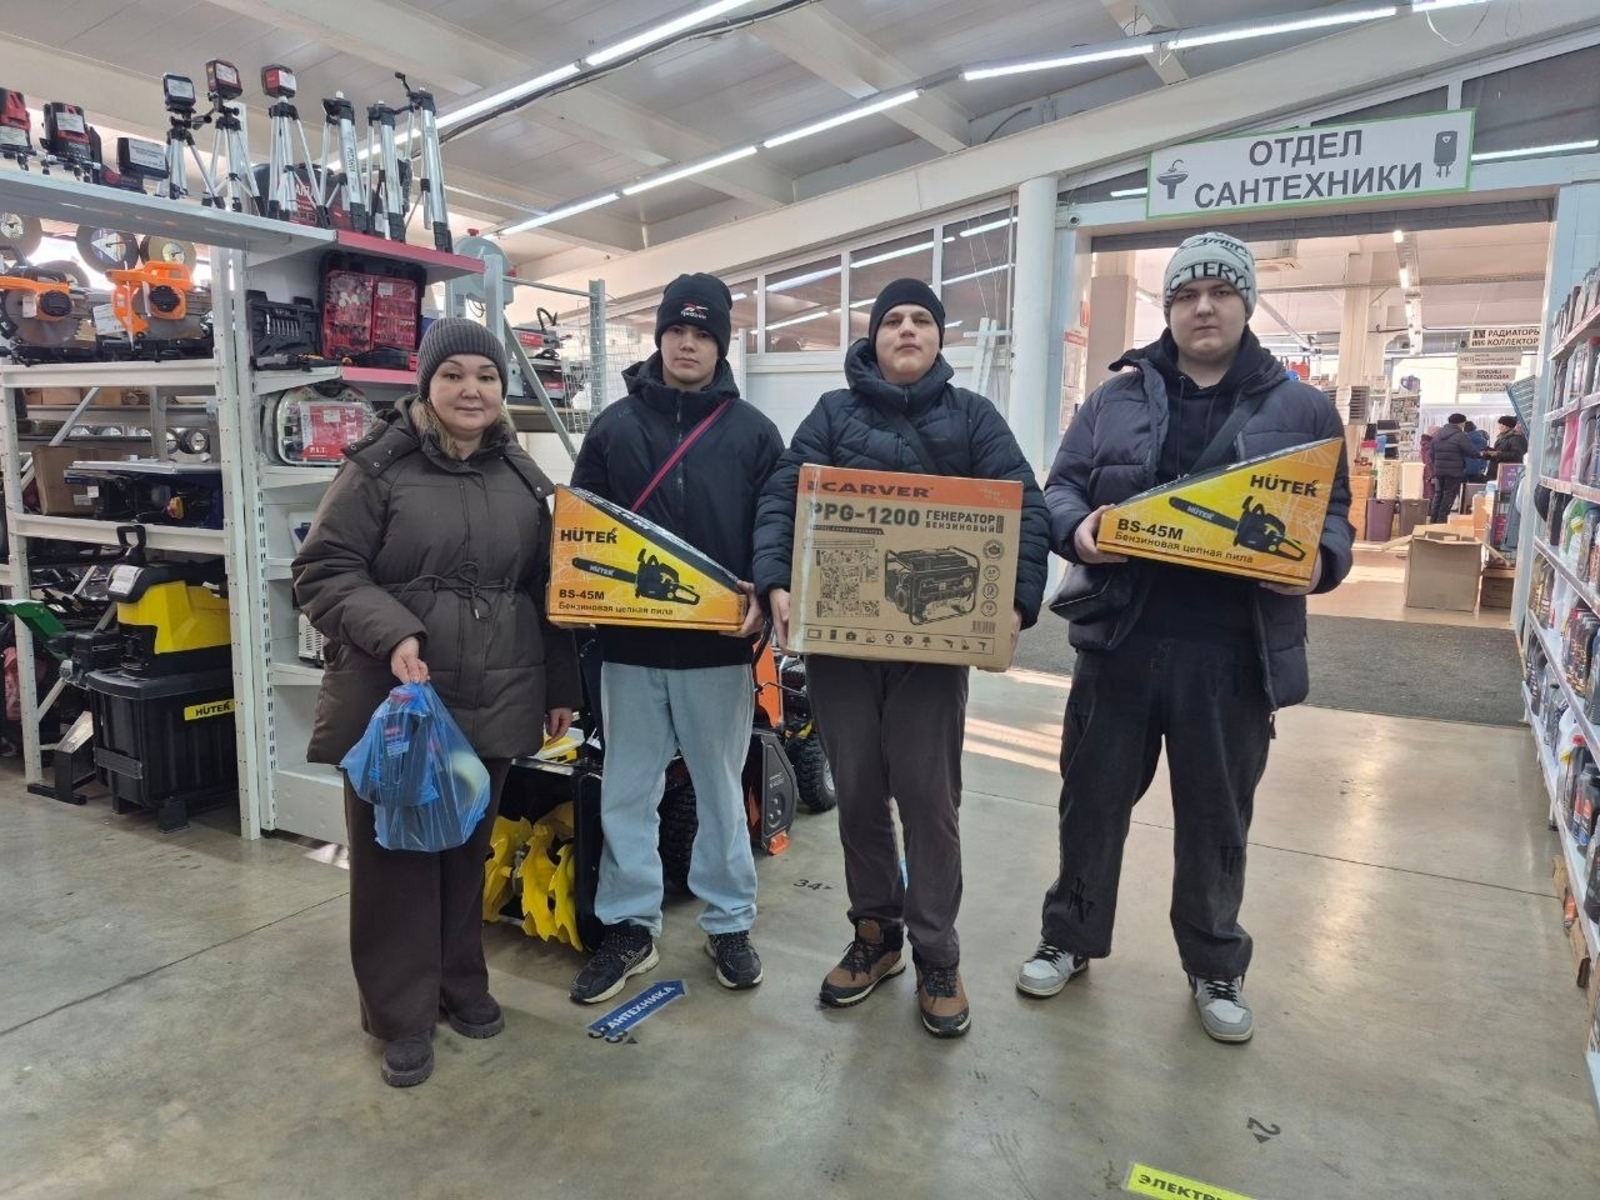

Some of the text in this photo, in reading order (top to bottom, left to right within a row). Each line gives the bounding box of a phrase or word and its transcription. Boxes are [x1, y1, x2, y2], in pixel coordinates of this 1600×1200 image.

[1249, 129, 1363, 167] ОТДЕЛ
[1194, 162, 1423, 208] САНТЕХНИКИ
[821, 482, 930, 498] CARVER
[1250, 473, 1318, 498] HÜTER
[810, 501, 920, 527] PPG-1200
[926, 509, 996, 524] ГЕНЕРАТОР
[560, 527, 618, 544] HÜTER
[925, 520, 995, 533] БЕНЗИНОВЫЙ
[1117, 518, 1184, 541] BS-45M
[1115, 531, 1253, 564] Бензиновая цепная пила
[559, 589, 605, 600] BS-45M
[558, 601, 613, 612] Бензиновая
[600, 986, 676, 1032] АНТЕХНИКА
